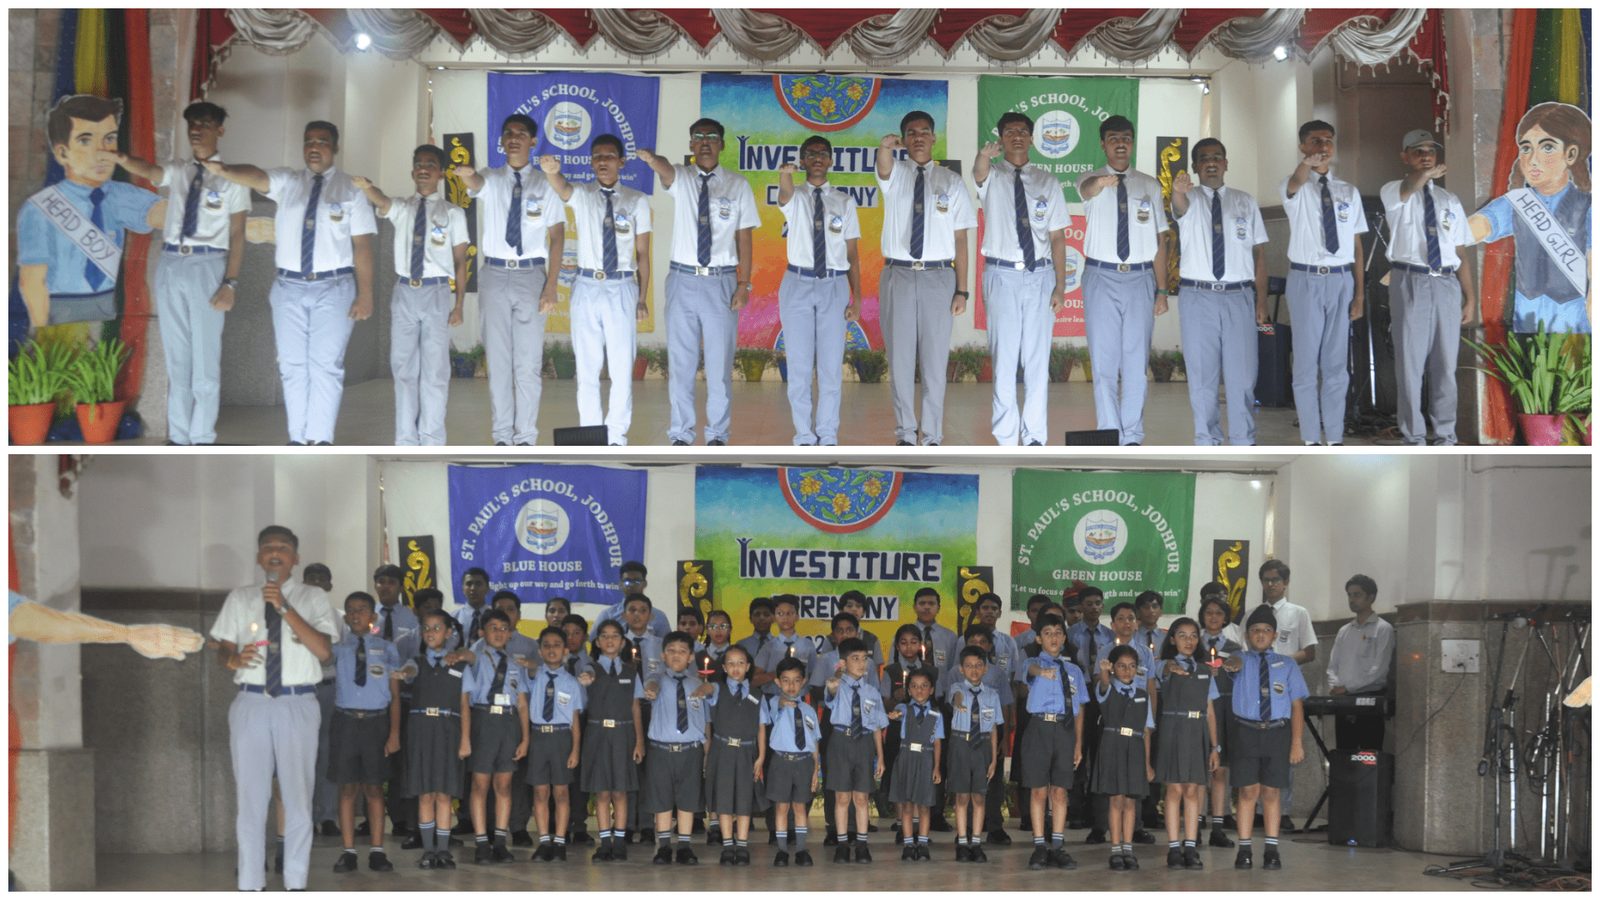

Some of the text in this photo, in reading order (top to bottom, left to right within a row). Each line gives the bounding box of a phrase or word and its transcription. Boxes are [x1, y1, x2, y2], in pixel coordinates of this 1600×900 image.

[1031, 93, 1088, 113] SCHOOL,
[542, 84, 599, 104] SCHOOL,
[601, 98, 637, 161] JODHPUR
[41, 193, 116, 260] HEAD BOY
[1516, 193, 1580, 272] HEAD GIRL
[461, 478, 623, 568] ST. PAUL'S SCHOOL, JODHPUR
[1017, 490, 1180, 574] ST. PAUL'S SCHOOL, JODHPUR
[503, 560, 583, 573] BLUE HOUSE
[737, 537, 942, 582] INVESTITURE
[549, 580, 564, 588] and
[564, 582, 575, 591] go
[575, 579, 596, 588] forth
[1052, 569, 1143, 582] GREEN HOUSE
[1038, 586, 1058, 595] focus
[1118, 589, 1133, 597] and
[1351, 754, 1377, 762] 2000
